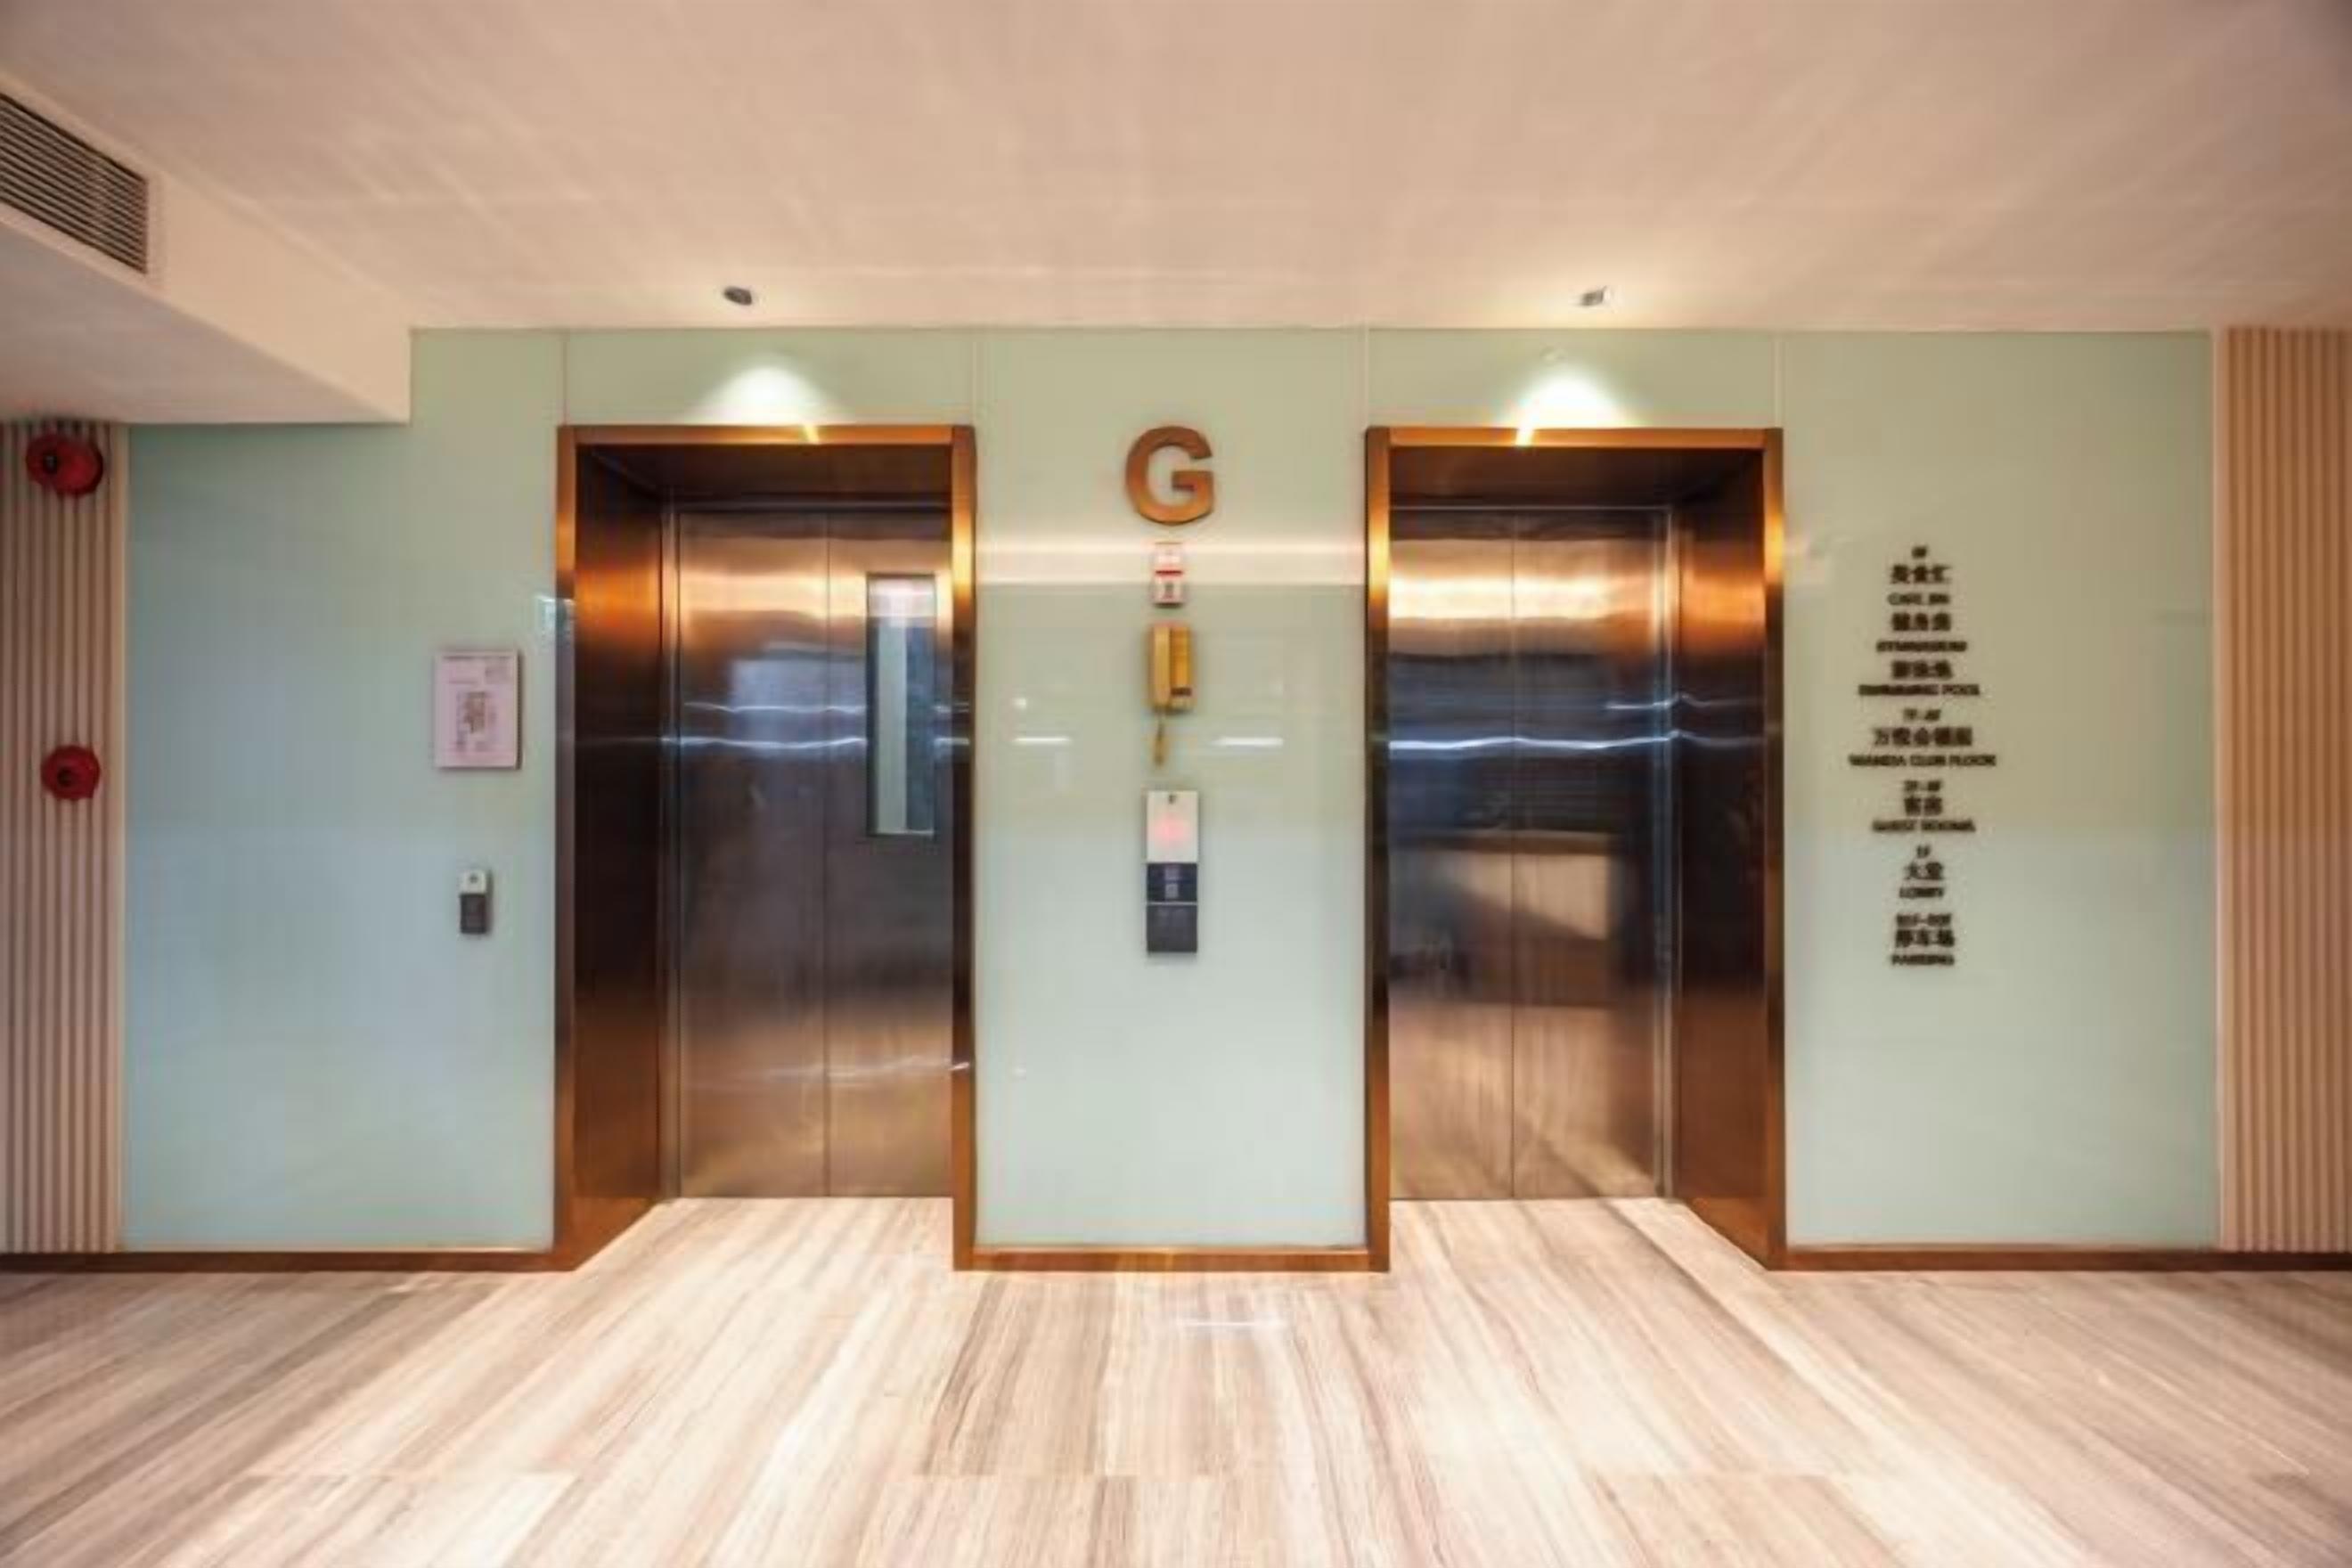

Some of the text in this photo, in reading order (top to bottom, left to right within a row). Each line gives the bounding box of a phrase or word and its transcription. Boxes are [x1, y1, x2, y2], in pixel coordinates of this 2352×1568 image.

[1125, 426, 1213, 524] G
[1941, 684, 1980, 696] POOL
[1849, 755, 1996, 767] WANDA CLUB FLOOR
[1872, 819, 1975, 833] GUEST ROOMS
[1903, 861, 1945, 880] 大堂
[1899, 886, 1945, 899] LOBBY
[1895, 928, 1956, 948] 停车场
[1891, 954, 1955, 966] PARKING
